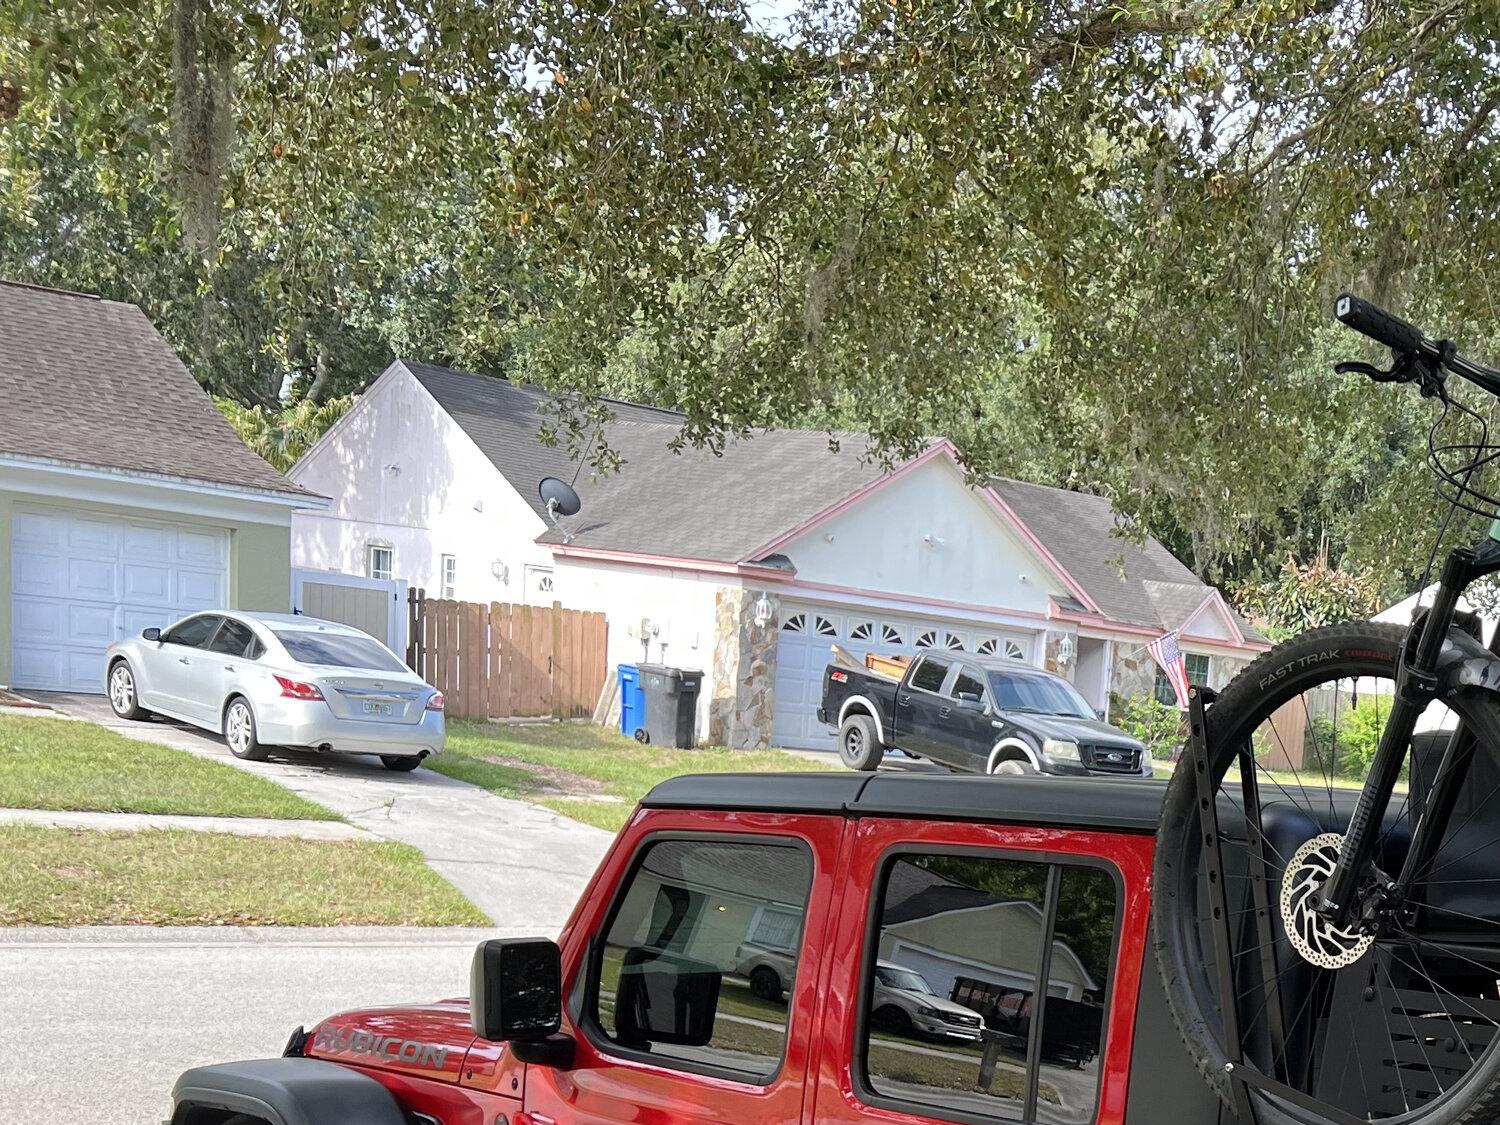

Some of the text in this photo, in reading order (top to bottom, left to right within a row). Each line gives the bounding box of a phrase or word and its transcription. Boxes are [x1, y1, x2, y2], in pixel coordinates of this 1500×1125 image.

[1259, 660, 1295, 691] FAST
[1295, 649, 1340, 668] TRAK
[316, 1026, 449, 1069] RUBICON
